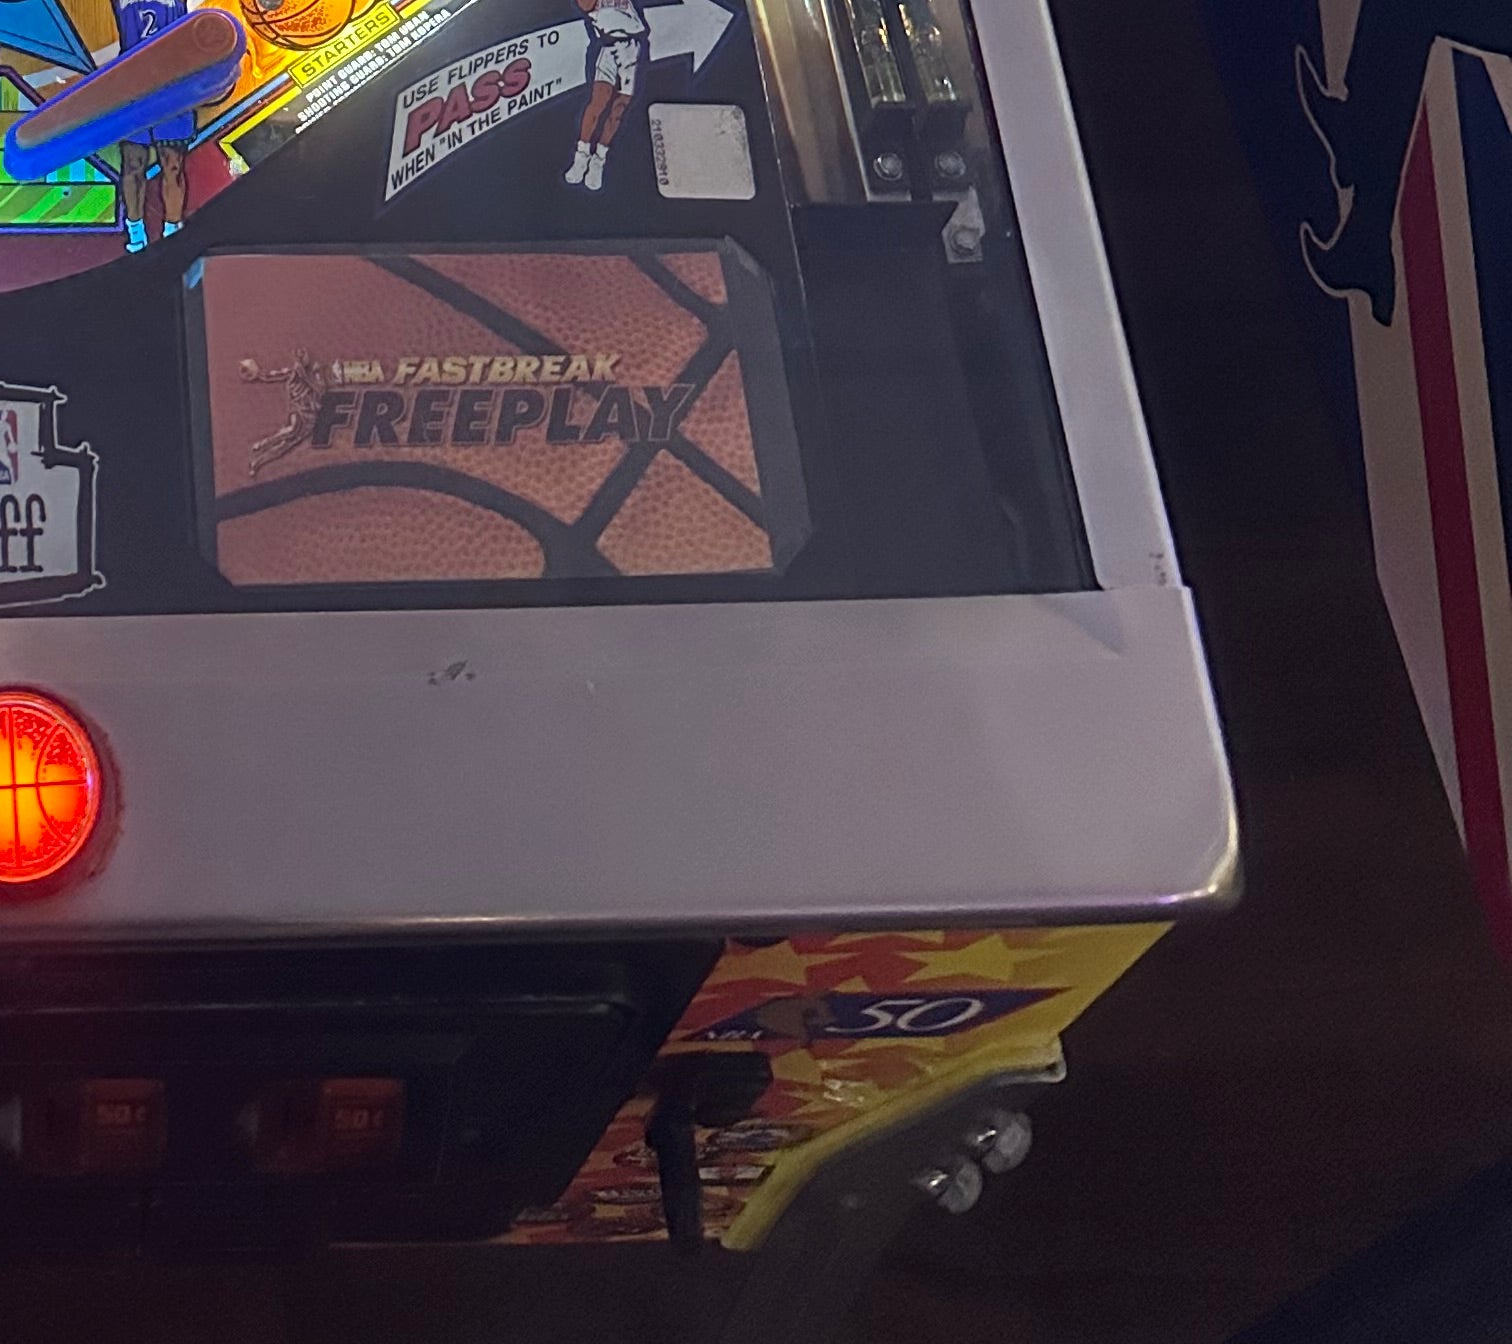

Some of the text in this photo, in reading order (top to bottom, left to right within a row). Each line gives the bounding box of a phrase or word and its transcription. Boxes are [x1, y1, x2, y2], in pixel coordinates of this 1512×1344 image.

[140, 9, 158, 39] 2
[302, 11, 390, 77] STARTERS
[297, 80, 351, 122] SHOOTING
[386, 36, 412, 58] TOM
[306, 30, 401, 103] POINT TOM
[403, 30, 560, 109] USE FLIPPERS TO
[391, 145, 435, 191] WHEN
[467, 107, 501, 136] THE
[507, 77, 562, 116] PAINT"
[402, 57, 532, 159] PASS
[343, 354, 623, 385] NBA FASTBREAK
[310, 383, 696, 450] FREEPLAY
[824, 997, 984, 1033] 50
